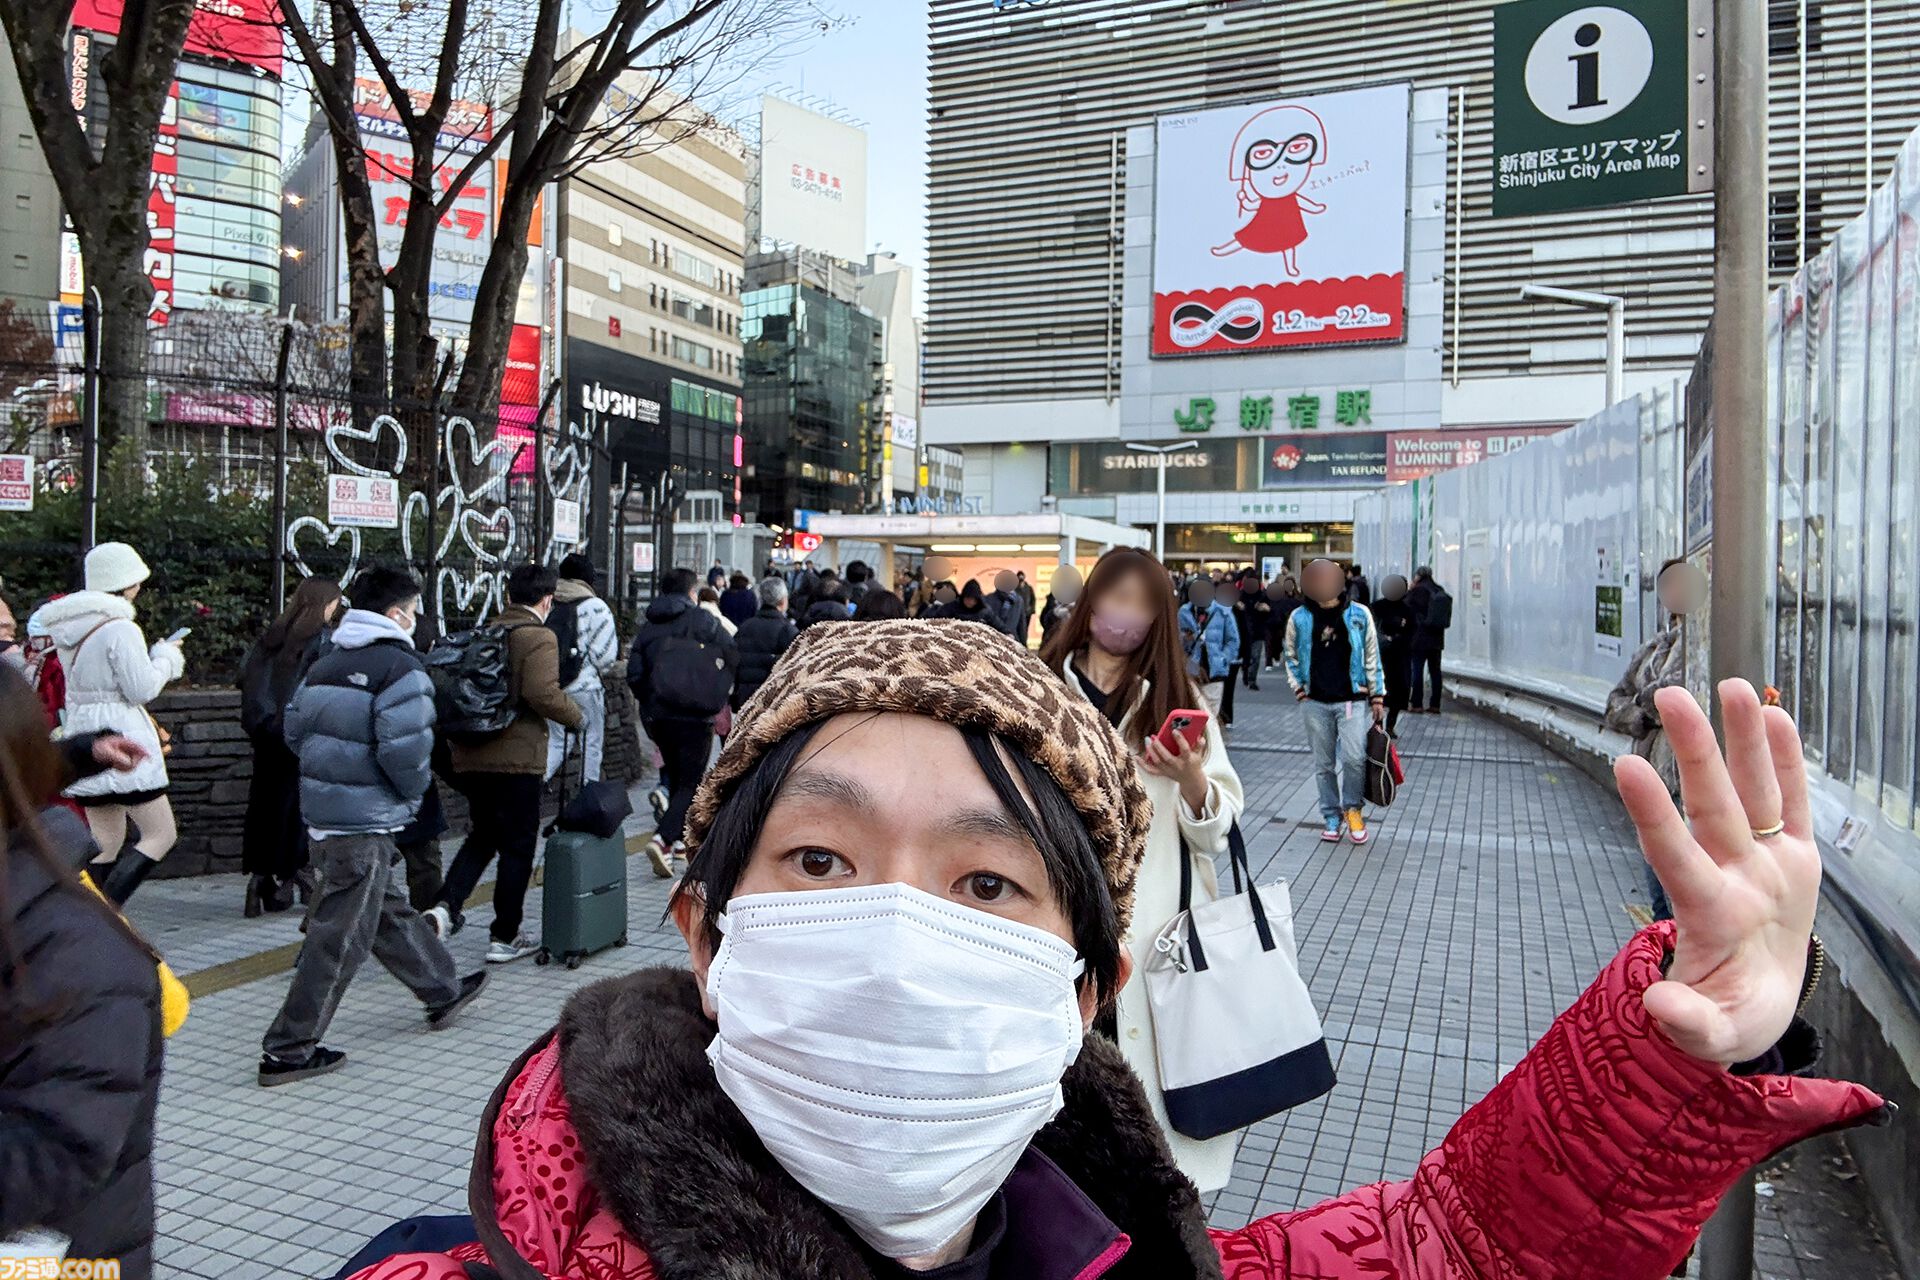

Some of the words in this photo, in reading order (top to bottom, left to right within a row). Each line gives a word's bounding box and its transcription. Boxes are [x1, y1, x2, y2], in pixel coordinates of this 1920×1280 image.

[1499, 129, 1682, 173] 新宿区エリアマップ
[1499, 167, 1566, 188] Shinjuku
[1570, 162, 1601, 180] City
[1605, 157, 1642, 174] Area
[1646, 153, 1681, 171] Map
[1275, 312, 1302, 331] 1.2
[1339, 307, 1368, 326] 2.2
[1173, 398, 1216, 432] JR
[1240, 390, 1371, 431] 新宿駅
[1394, 438, 1462, 452] Welcome
[1465, 438, 1482, 450] to
[1104, 453, 1209, 469] STARBUCKS
[1395, 452, 1452, 466] LUMINE
[1456, 451, 1482, 464] EST
[1330, 466, 1349, 476] TAX
[1350, 465, 1387, 476] REFUND
